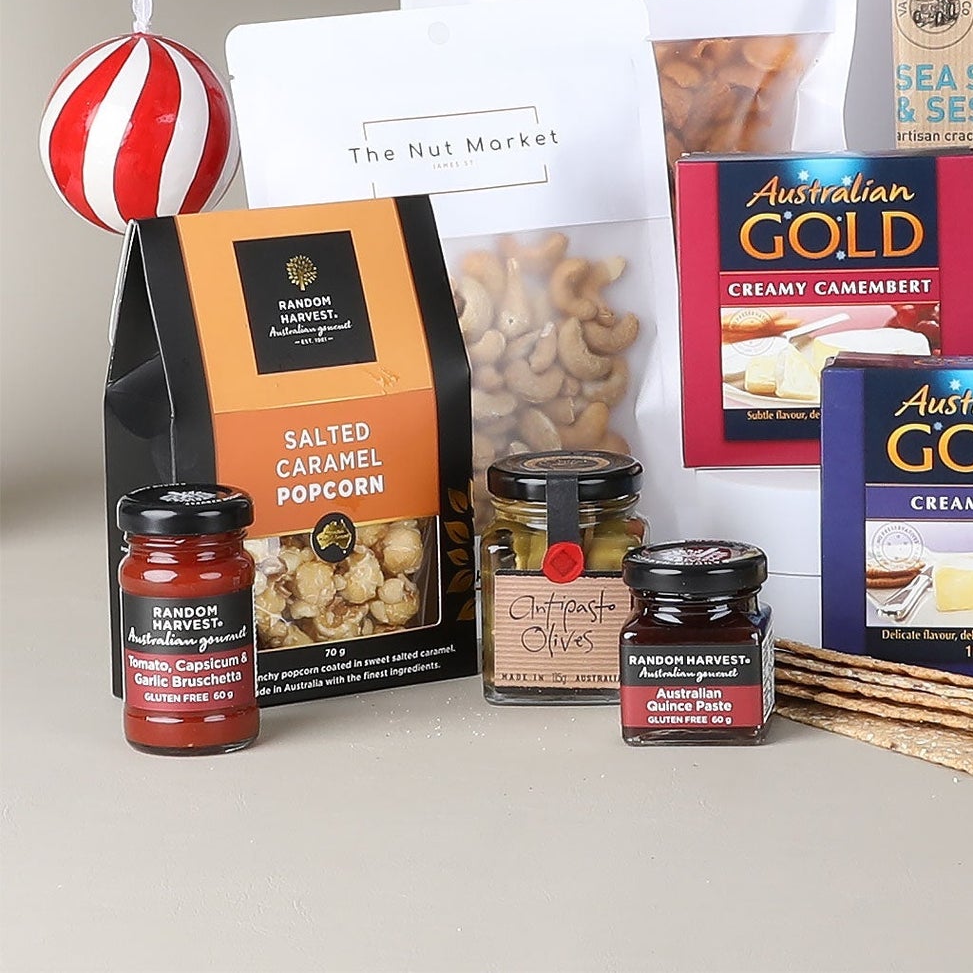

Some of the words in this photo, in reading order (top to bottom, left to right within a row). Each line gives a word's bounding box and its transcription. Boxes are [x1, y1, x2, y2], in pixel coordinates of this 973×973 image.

[896, 64, 958, 91] SEA
[898, 96, 915, 123] &
[348, 147, 395, 163] The
[409, 142, 453, 158] Nut
[467, 130, 559, 152] Market
[746, 173, 914, 207] Australian
[740, 210, 924, 259] GOLD
[729, 281, 807, 296] CREAMY
[814, 279, 931, 295] CAMEMBERT
[279, 296, 331, 310] RANDOM
[269, 325, 316, 337] Australian
[747, 410, 773, 420] Subtle
[776, 410, 807, 419] flavour,
[284, 422, 369, 449] SALTED
[276, 449, 382, 478] CARAMEL
[277, 475, 384, 505] POPCORN
[153, 606, 218, 618] RANDOM
[128, 627, 198, 646] Australian
[521, 623, 593, 658] Olives
[882, 630, 921, 640] Delicate
[923, 630, 957, 641] flavour,
[282, 666, 319, 679] popcorn
[321, 661, 351, 673] coated
[354, 658, 363, 667] in
[364, 656, 390, 667] sweet
[392, 651, 418, 662] salted
[420, 645, 455, 658] caramel.
[325, 649, 337, 657] 70
[339, 649, 345, 657] g
[629, 656, 683, 665] RANDOM
[128, 655, 172, 673] Tomato,
[175, 657, 239, 672] Capsicum
[241, 652, 247, 663] &
[134, 673, 168, 687] Garlic
[172, 671, 241, 687] Bruschetta
[273, 685, 282, 693] in
[284, 679, 323, 693] Australia
[326, 676, 344, 686] with
[347, 674, 361, 683] the
[364, 670, 388, 681] finest
[390, 661, 440, 676] ingredients.
[639, 667, 696, 678] Australian
[696, 668, 738, 682] gourmet
[144, 692, 180, 702] GLUTEN
[184, 692, 209, 702] FREE
[656, 688, 721, 699] Australian
[647, 701, 692, 712] Quince
[696, 701, 732, 711] Paste
